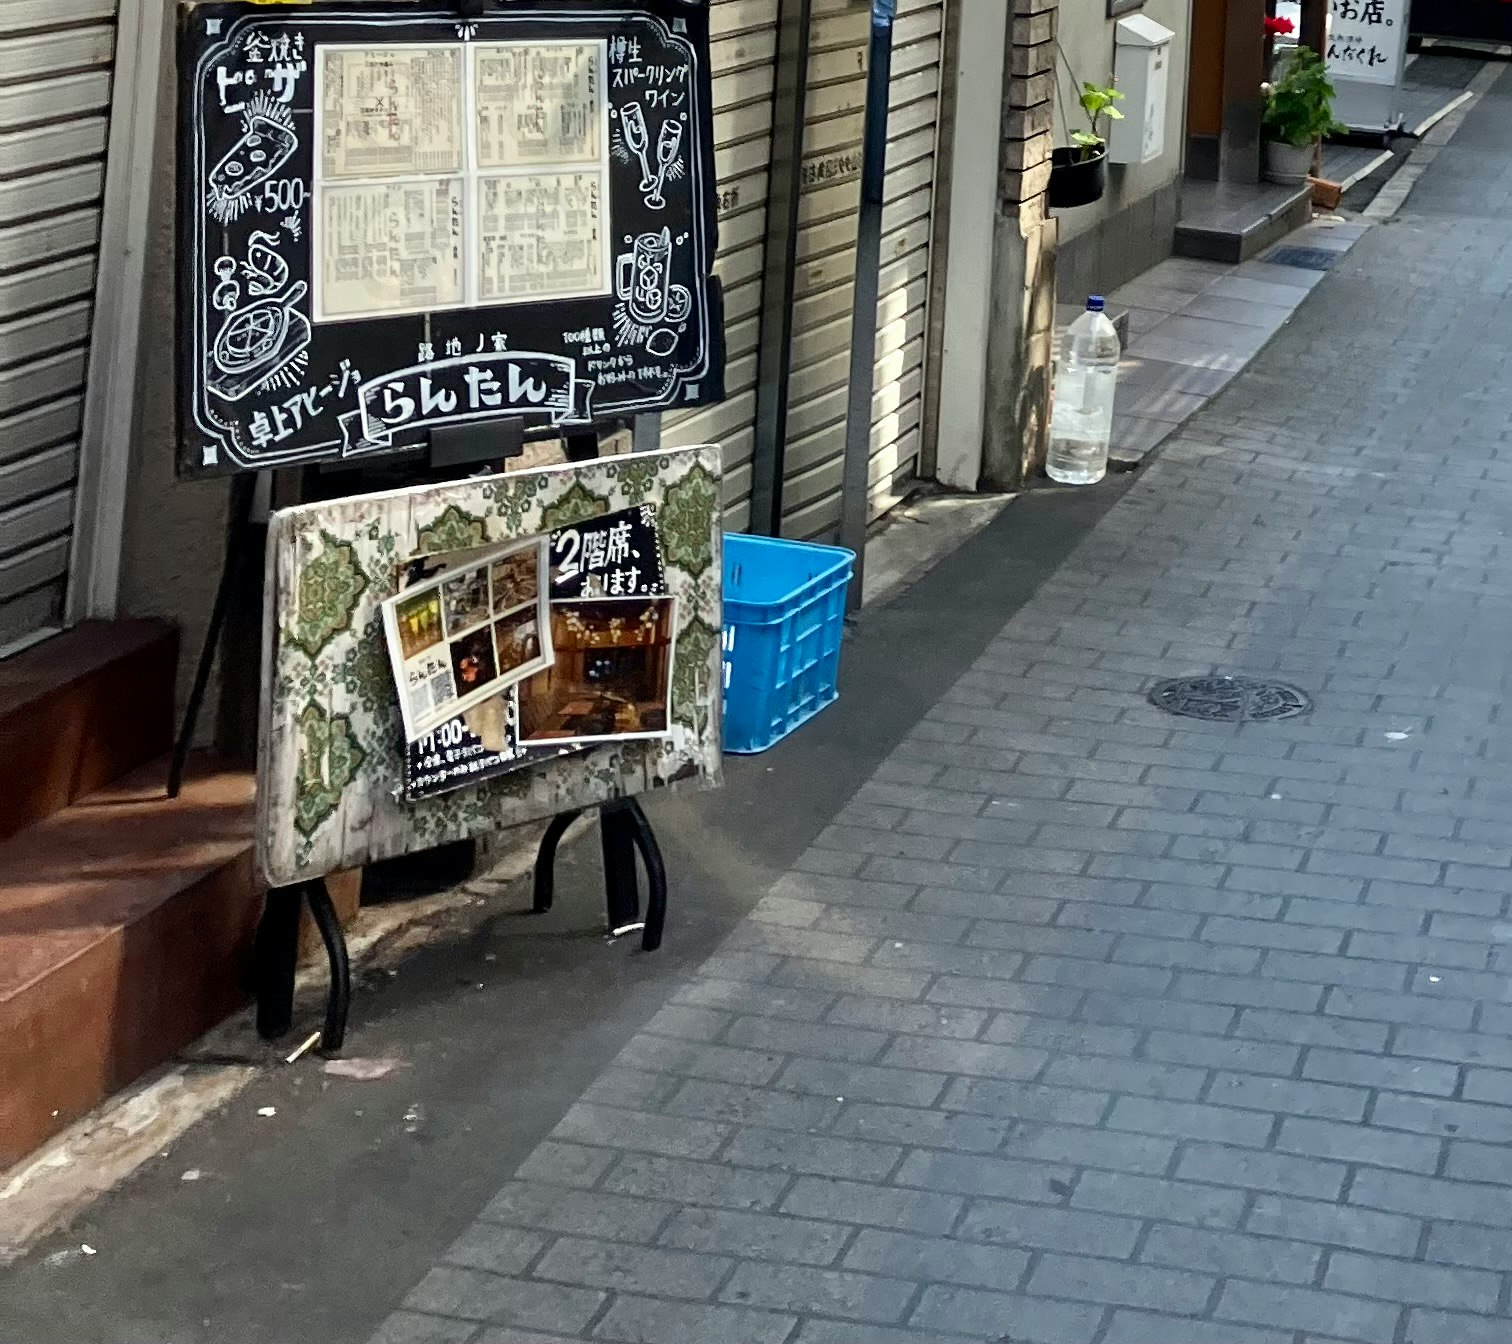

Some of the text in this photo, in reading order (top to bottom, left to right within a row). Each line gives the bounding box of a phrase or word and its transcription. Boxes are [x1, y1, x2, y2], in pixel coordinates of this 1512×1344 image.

[243, 30, 305, 63] 釜焼き
[216, 60, 307, 114] ピザ
[612, 64, 689, 88] スパークリング
[645, 89, 686, 108] ワイン
[249, 357, 362, 448] 卓上アヒージョ
[382, 363, 547, 424] らんたん
